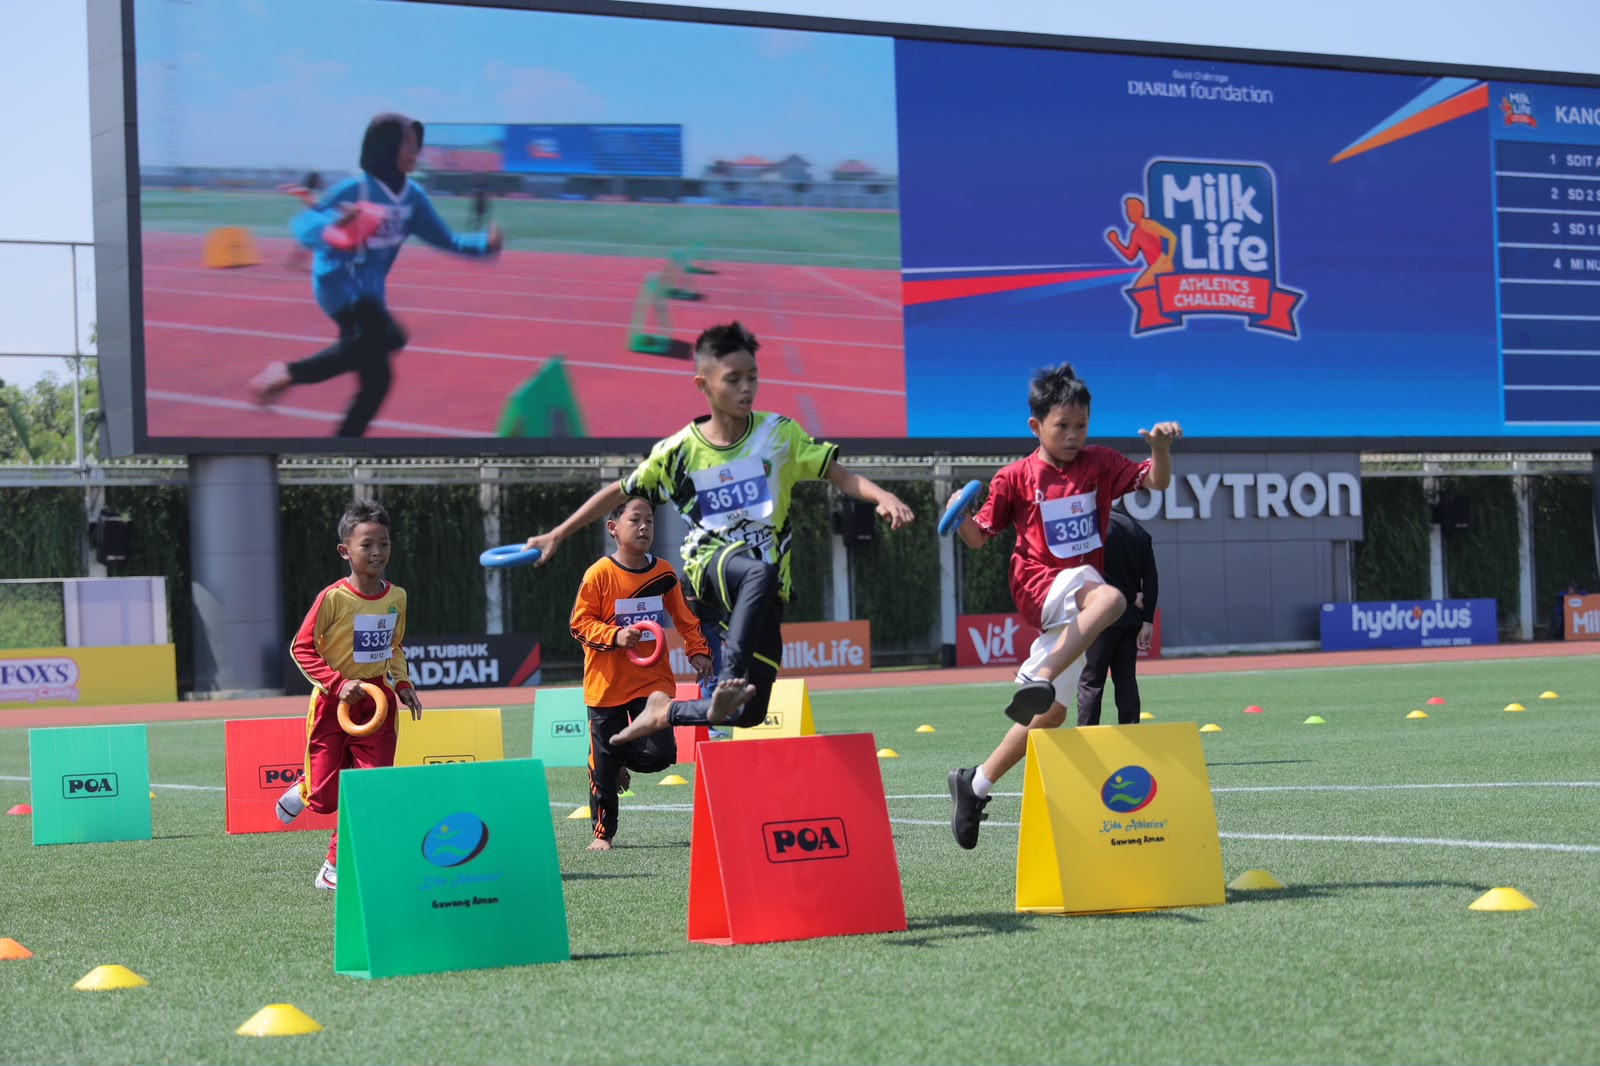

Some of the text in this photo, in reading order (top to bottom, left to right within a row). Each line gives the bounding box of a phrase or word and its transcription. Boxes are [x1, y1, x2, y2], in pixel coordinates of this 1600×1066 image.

[1127, 80, 1274, 103] DJARUM foundation
[1549, 153, 1557, 166] 1
[1566, 154, 1593, 168] SDIT
[1162, 173, 1263, 225] Milk
[1550, 187, 1559, 200] 2
[1567, 188, 1584, 201] SD
[1586, 189, 1594, 201] 2
[1552, 222, 1560, 235] 3
[1569, 223, 1586, 235] SD
[1181, 222, 1269, 272] Life
[1553, 258, 1562, 270] 4
[1179, 277, 1249, 294] ATHLETICS
[1174, 293, 1256, 309] CHALLENGE
[706, 481, 759, 510] 3619
[1112, 471, 1362, 521] OLYTRON
[1055, 515, 1094, 541] 3306
[1072, 543, 1081, 552] KU
[1352, 602, 1472, 638] hydroplus
[968, 617, 1020, 665] Vit
[427, 644, 488, 659] TUBRUK
[781, 640, 864, 669] ilkLife
[408, 659, 499, 686] ADJAH
[555, 723, 581, 734] POA
[763, 715, 781, 726] OA
[69, 778, 113, 793] POA
[772, 826, 841, 853] POA
[1111, 835, 1165, 846] Gawang Aman
[432, 896, 499, 909] Gawang Aman
